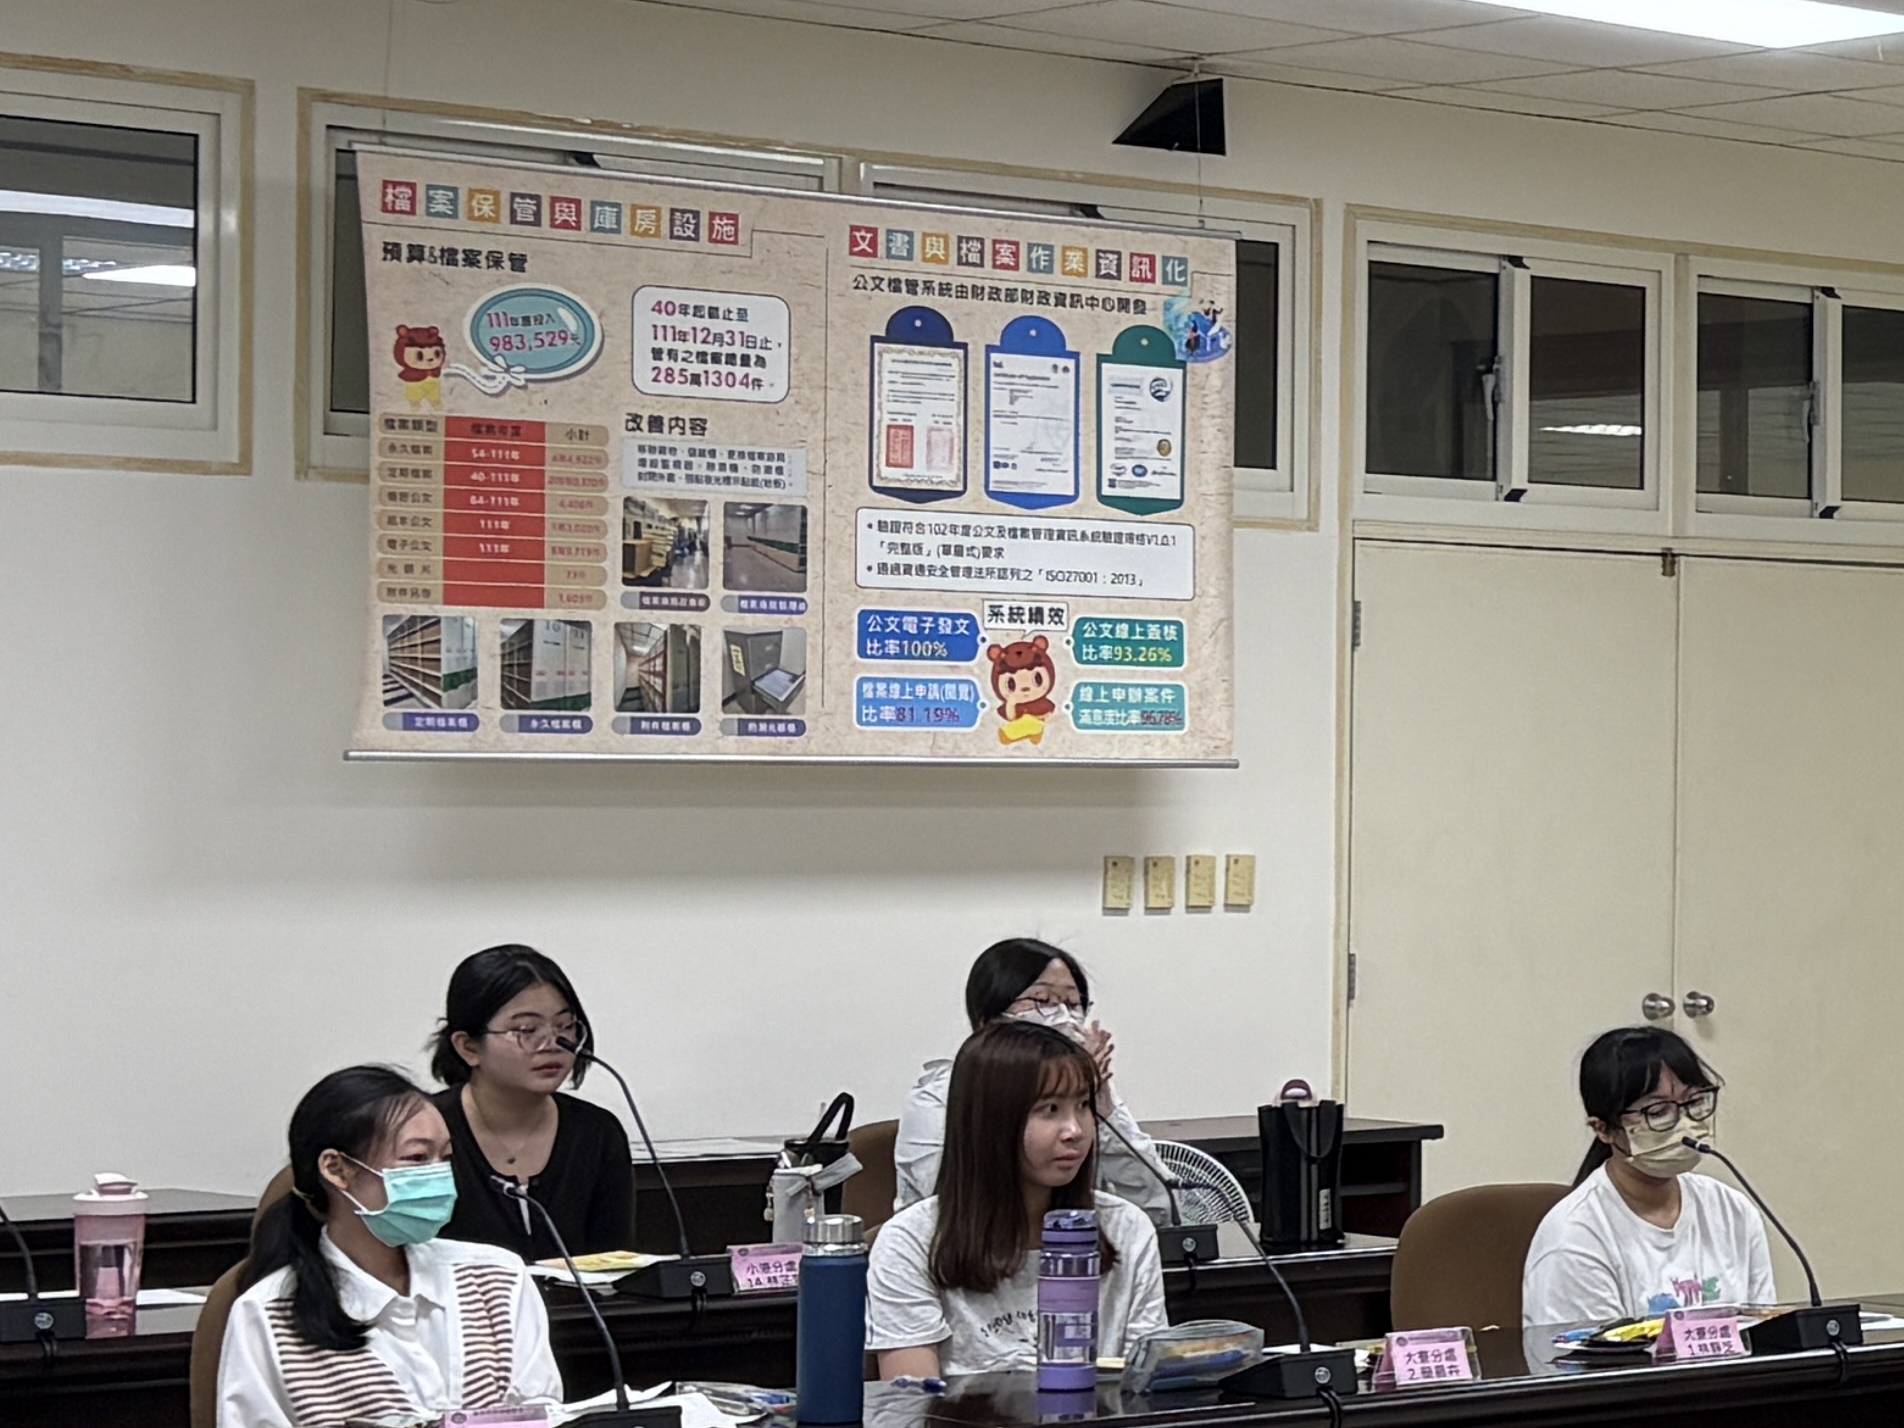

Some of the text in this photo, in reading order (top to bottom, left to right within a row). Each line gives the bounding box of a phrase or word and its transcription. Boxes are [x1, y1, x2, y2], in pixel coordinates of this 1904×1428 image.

[384, 183, 735, 241] 檔案保管與庫房設施
[382, 241, 528, 272] 預算&檔案保管
[852, 229, 1186, 282] 文書與檔案作業資訊化
[565, 428, 590, 442] 小計
[625, 412, 708, 437] 改善內容
[866, 615, 971, 636] 公文電子發文
[987, 603, 1065, 626] 系統績效
[866, 640, 948, 658] 比率100%
